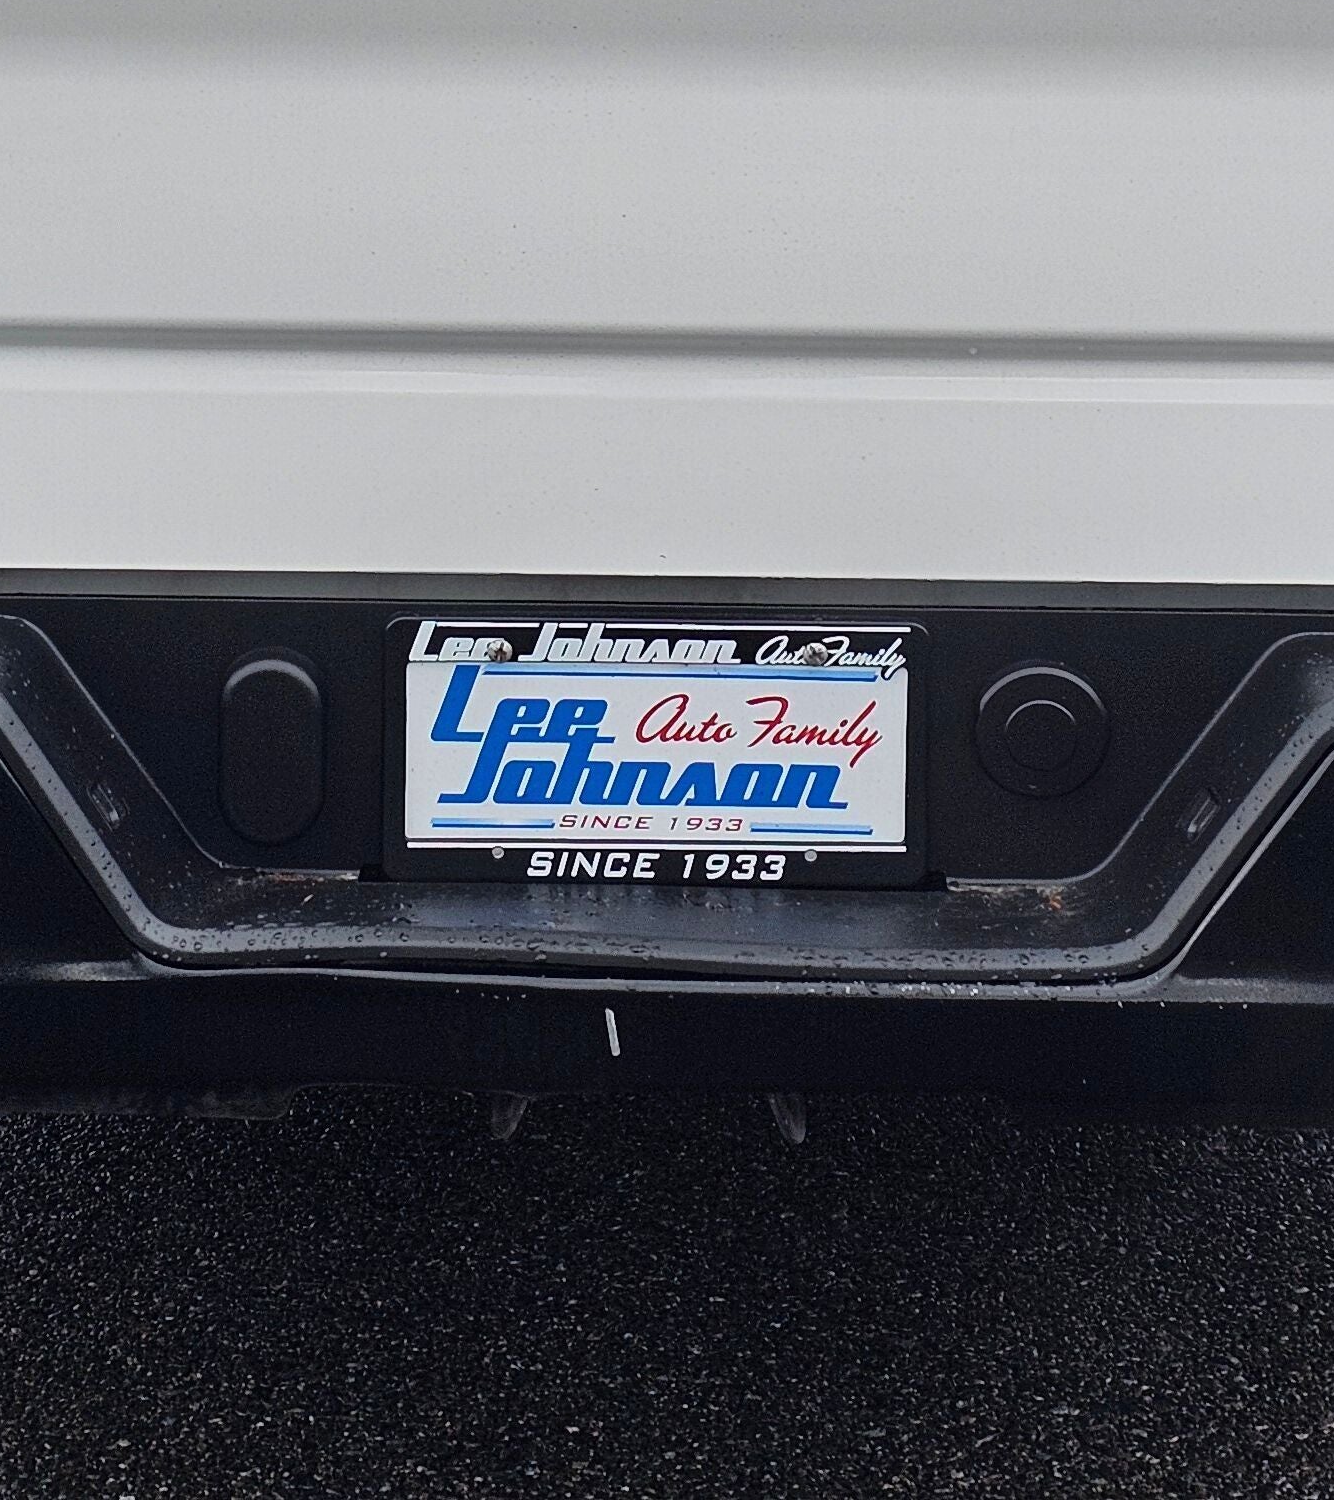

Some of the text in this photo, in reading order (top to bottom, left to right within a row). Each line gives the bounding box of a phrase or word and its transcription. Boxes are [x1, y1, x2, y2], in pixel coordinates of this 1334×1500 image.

[517, 622, 742, 664] Johnson
[754, 636, 808, 666] Aut
[821, 635, 907, 679] Family
[430, 665, 615, 743] Lee
[635, 693, 883, 768] Auto Family
[437, 728, 849, 809] Johnson
[559, 814, 744, 833] SINCE 1933
[527, 851, 786, 882] SINCE 1933
